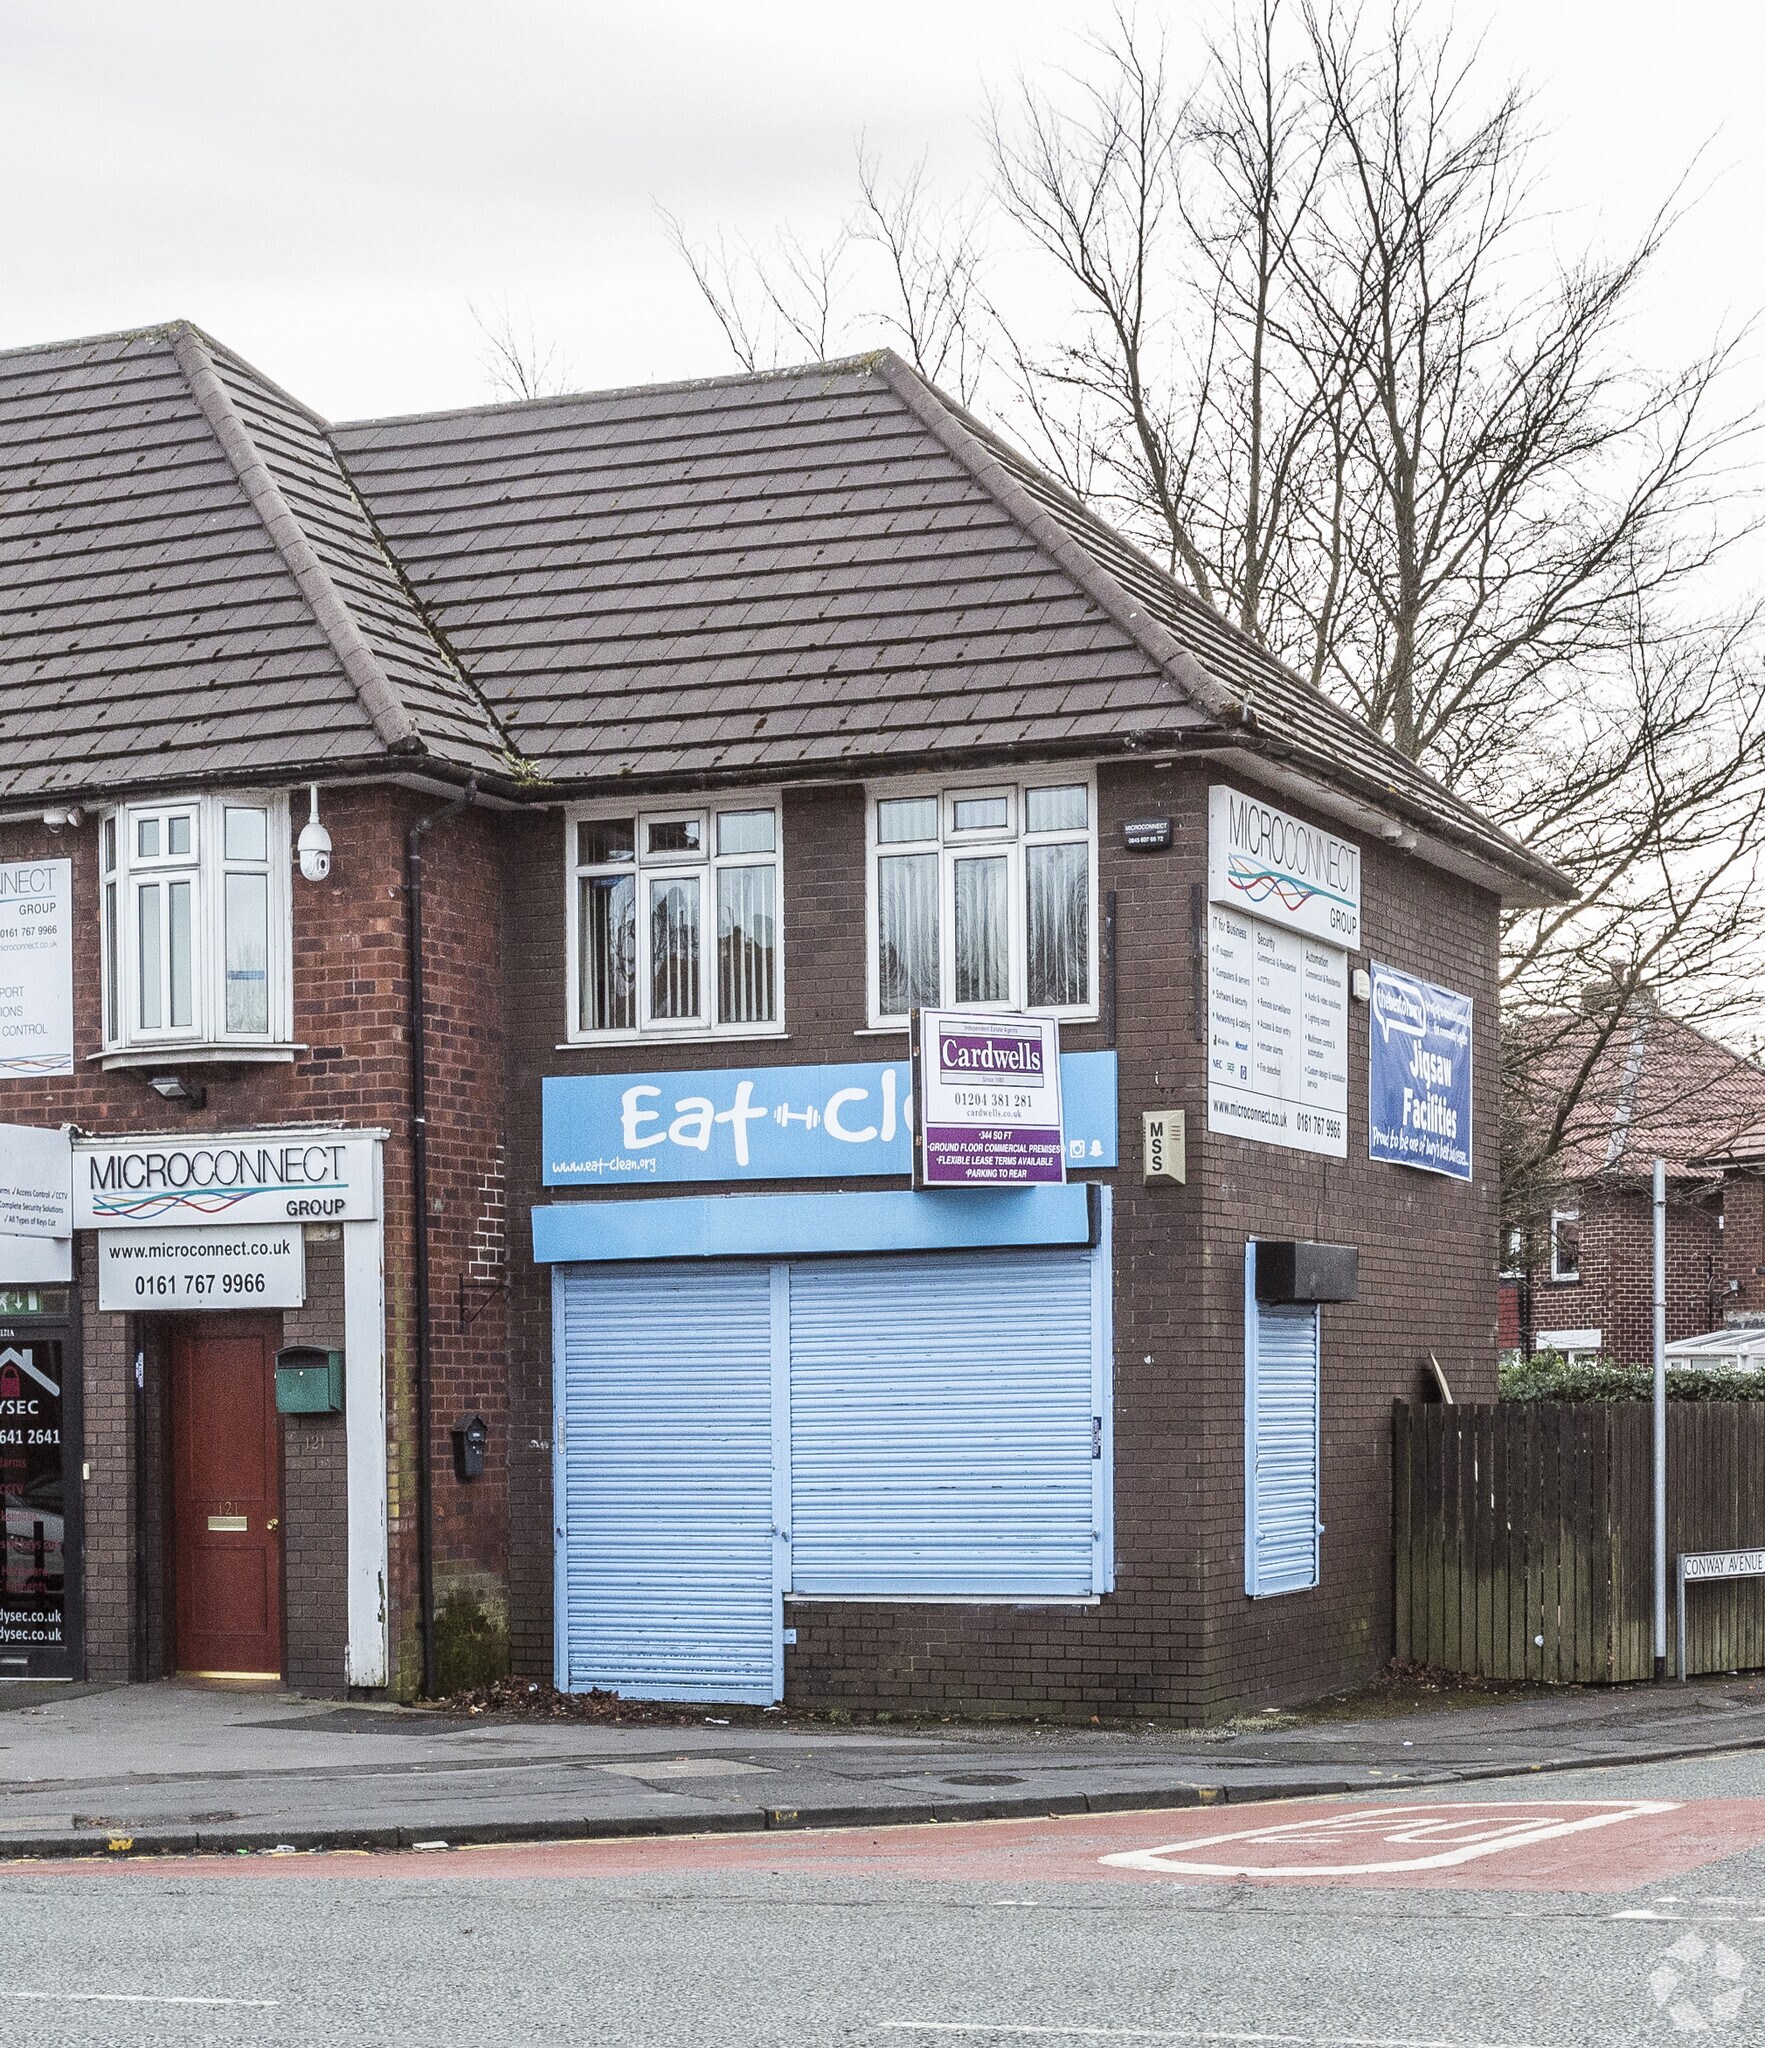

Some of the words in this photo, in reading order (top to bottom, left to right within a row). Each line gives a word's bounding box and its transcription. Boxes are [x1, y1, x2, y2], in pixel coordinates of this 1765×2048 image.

[1125, 822, 1168, 831] MICROCONNECT
[1230, 795, 1357, 895] MICROCONNECT
[0, 868, 56, 895] NECT
[19, 902, 56, 916] GROUP
[1212, 917, 1218, 930] IT
[1218, 918, 1226, 931] for
[1226, 921, 1247, 940] Business
[1330, 907, 1357, 936] GROUP
[0, 928, 18, 938] 0161
[21, 926, 35, 936] 767
[38, 924, 57, 936] 9966
[1257, 932, 1275, 952] Security
[1305, 950, 1329, 968] Automation
[2, 1023, 48, 1037] CONTROL
[942, 1039, 1041, 1071] Cardwells
[1212, 1059, 1223, 1070] NEC
[1409, 1039, 1452, 1089] Jigsaw
[955, 1093, 987, 1106] 01204
[992, 1094, 1009, 1107] 381
[1014, 1095, 1033, 1108] 281
[620, 1081, 768, 1167] Eat
[823, 1069, 913, 1143] cl
[967, 1109, 1022, 1118] cardwells.co.uk
[1213, 1099, 1288, 1128] www.microconnect.co.uk
[1297, 1112, 1312, 1134] 0161
[1314, 1116, 1325, 1136] 767
[1326, 1119, 1341, 1139] 9966
[1402, 1087, 1458, 1139] Facilities
[993, 1131, 1002, 1140] SQ
[1003, 1131, 1013, 1140] FT
[1373, 1126, 1390, 1148] Proud
[1390, 1129, 1399, 1149] to
[1399, 1128, 1409, 1151] be
[1409, 1138, 1419, 1152] one
[1419, 1134, 1426, 1156] of
[960, 1143, 983, 1152] FLOOR
[985, 1144, 1027, 1153] COMMERCIAL
[1028, 1144, 1061, 1154] PREMISES
[1150, 1121, 1164, 1172] MSS
[90, 1145, 346, 1190] MICROCONNECT
[552, 1156, 656, 1175] www.eat-clean.org
[971, 1156, 994, 1165] LEASE
[995, 1156, 1017, 1166] TERMS
[1017, 1157, 1054, 1166] AVAILABLE
[998, 1169, 1008, 1178] TO
[1009, 1169, 1027, 1178] REAR
[16, 1188, 32, 1197] Access
[33, 1189, 51, 1199] Control
[56, 1191, 68, 1200] CCTV
[23, 1202, 41, 1213] Security
[43, 1204, 64, 1214] Solutions
[286, 1199, 346, 1216] GROUP
[16, 1216, 30, 1225] Types
[31, 1217, 36, 1225] of
[37, 1218, 47, 1227] Keys
[48, 1219, 56, 1227] Cut
[109, 1239, 291, 1259] www.microconnect.co.uk
[135, 1275, 177, 1295] 0161
[184, 1274, 216, 1294] 767
[222, 1273, 265, 1293] 9966
[0, 1430, 23, 1444] 641
[28, 1430, 60, 1444] 2641
[306, 1434, 325, 1450] 121
[219, 1501, 239, 1516] 121
[1685, 1557, 1726, 1575] CONWAY
[1728, 1554, 1763, 1572] AVENUE
